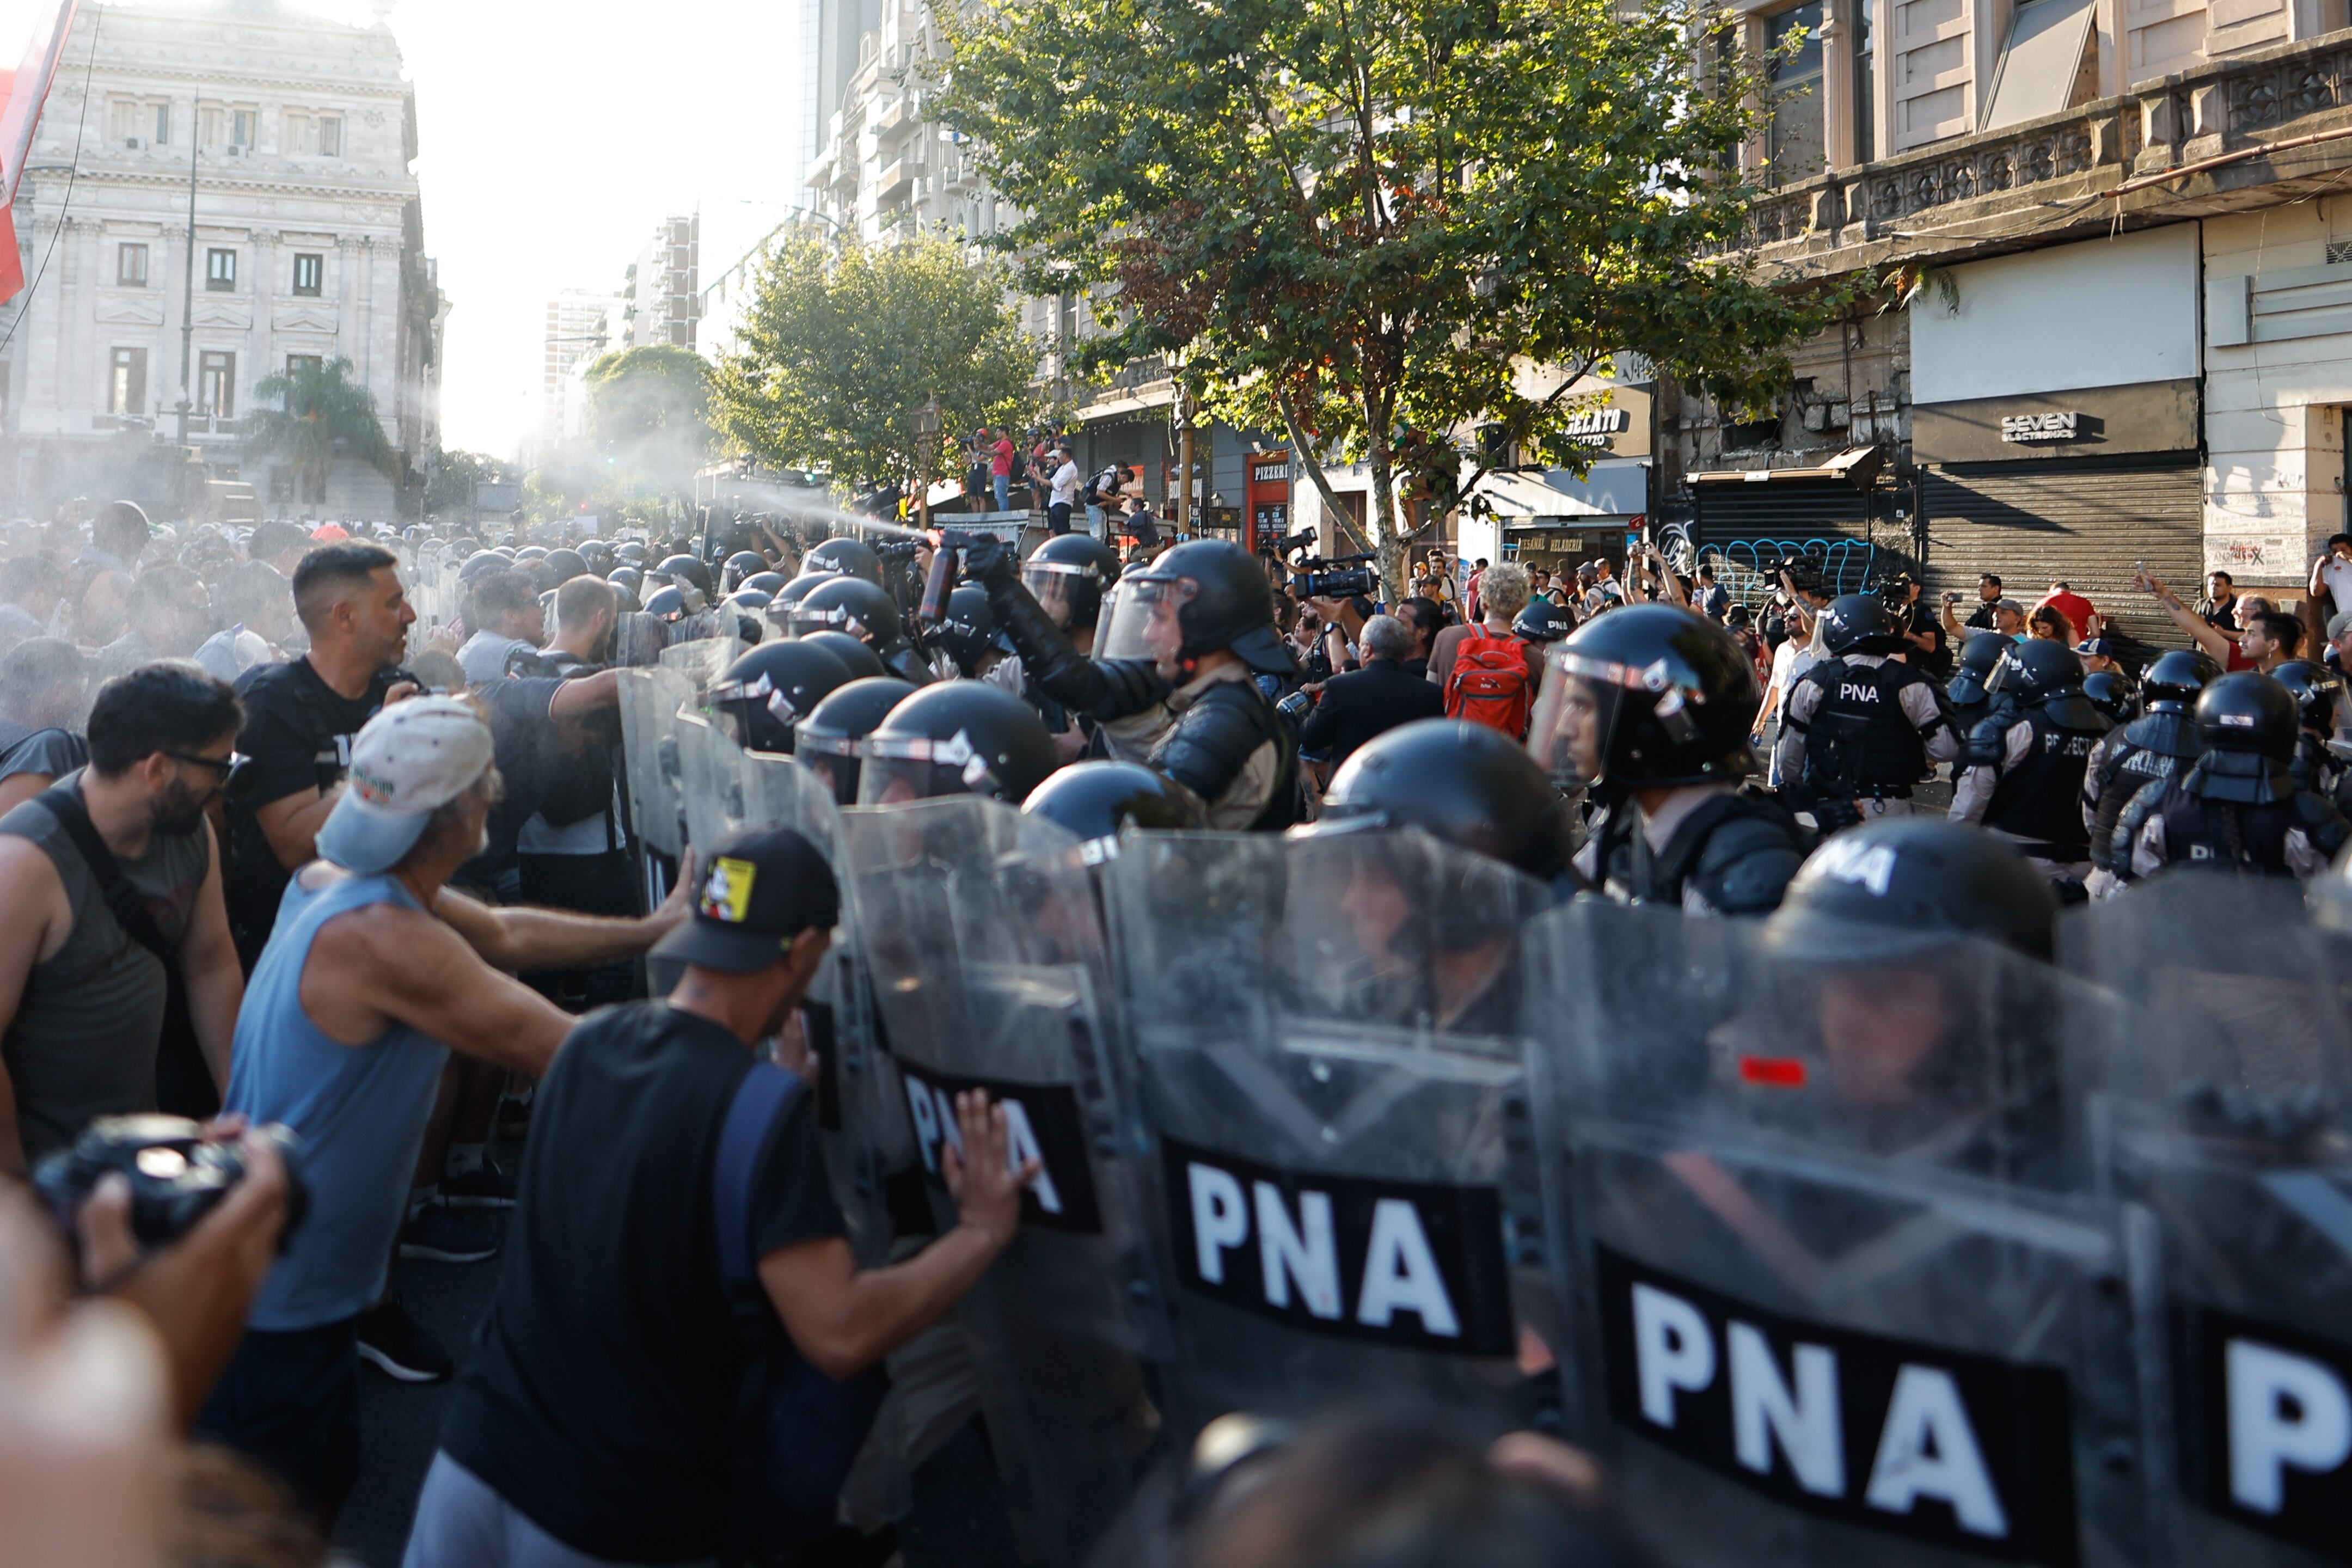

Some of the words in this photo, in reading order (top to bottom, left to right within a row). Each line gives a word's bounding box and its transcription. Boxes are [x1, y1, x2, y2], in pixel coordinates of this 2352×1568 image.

[1565, 409, 1621, 435] GELATO
[2001, 412, 2077, 433] SEVEN
[2001, 428, 2077, 442] ELECTRONICS
[1255, 464, 1288, 481] PIZZERI
[1169, 479, 1203, 499] BOON
[1550, 538, 1583, 552] HELADERIA
[1547, 620, 1568, 630] PNA
[1840, 683, 1880, 703] PNA
[904, 1074, 1063, 1215] PNA
[1187, 1161, 1462, 1338] PNA
[1631, 1281, 2010, 1539] PNA
[2225, 1337, 2352, 1517] P
